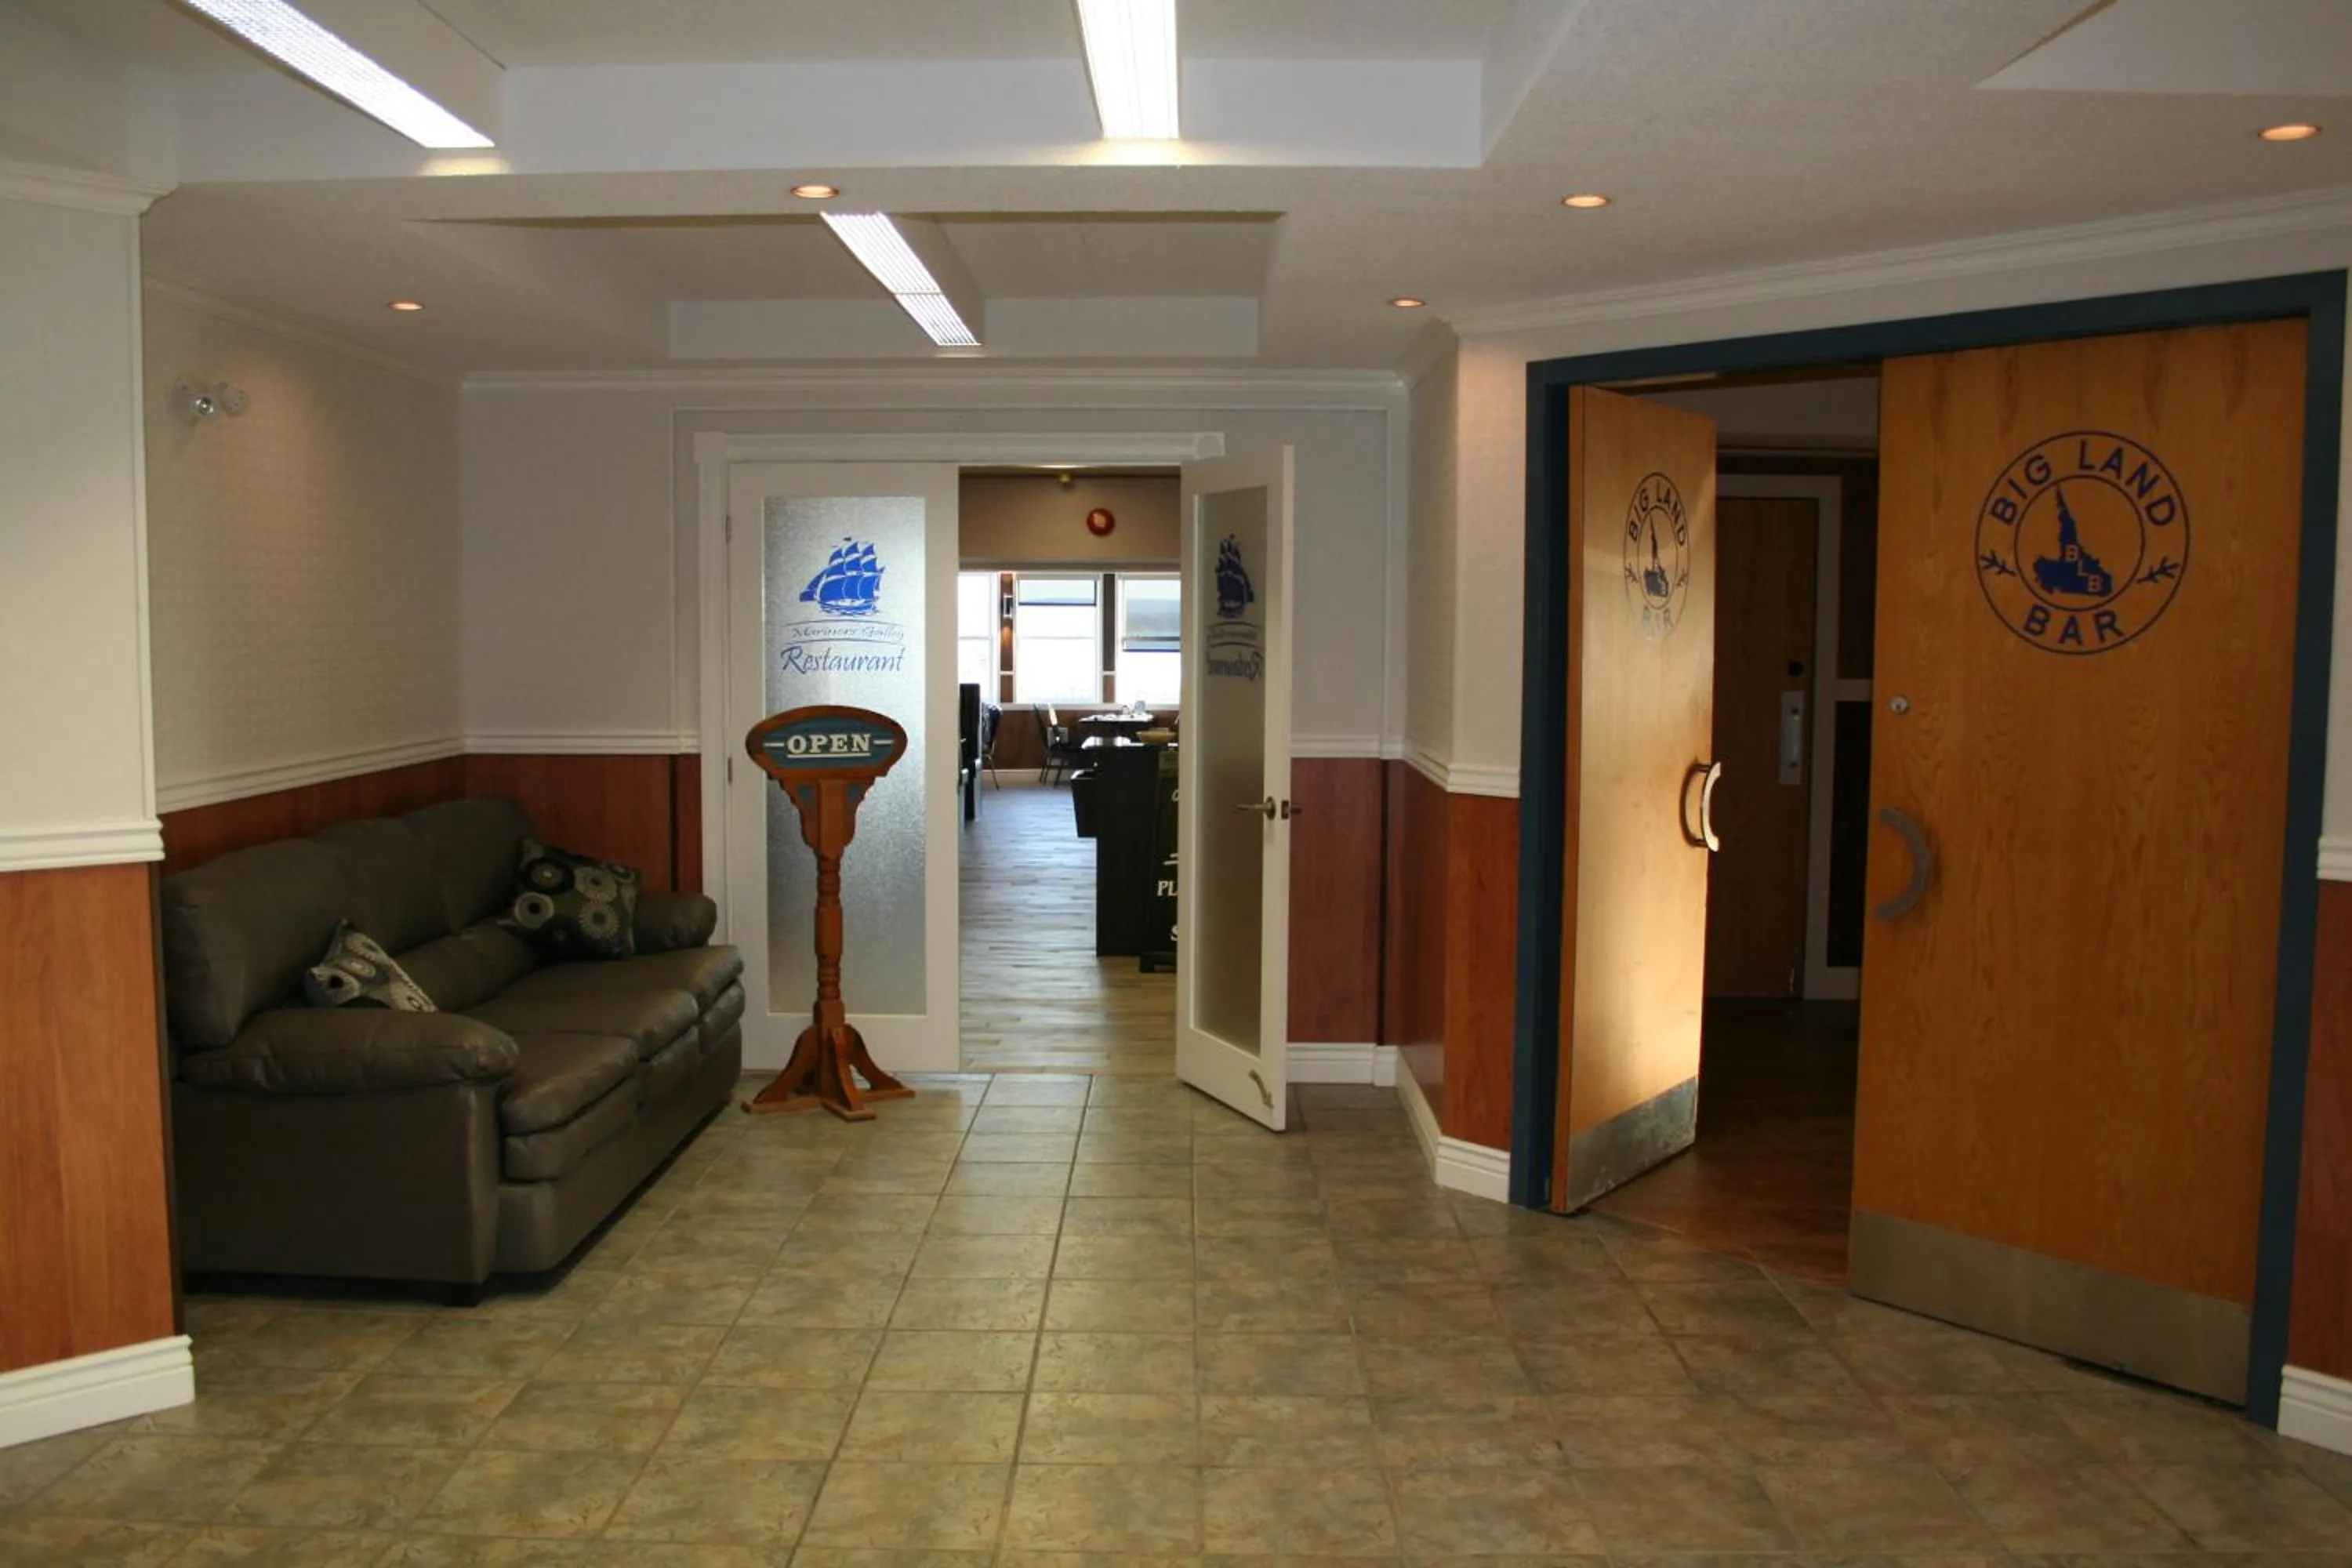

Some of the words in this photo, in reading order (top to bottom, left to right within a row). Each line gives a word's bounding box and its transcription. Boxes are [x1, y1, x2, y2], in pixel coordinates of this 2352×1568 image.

[1990, 454, 2052, 525] BIG
[2078, 439, 2176, 527] LAND
[1628, 488, 1650, 543] BIG
[2023, 603, 2125, 646] BAR
[779, 645, 906, 676] Restaurant
[786, 733, 871, 754] OPEN
